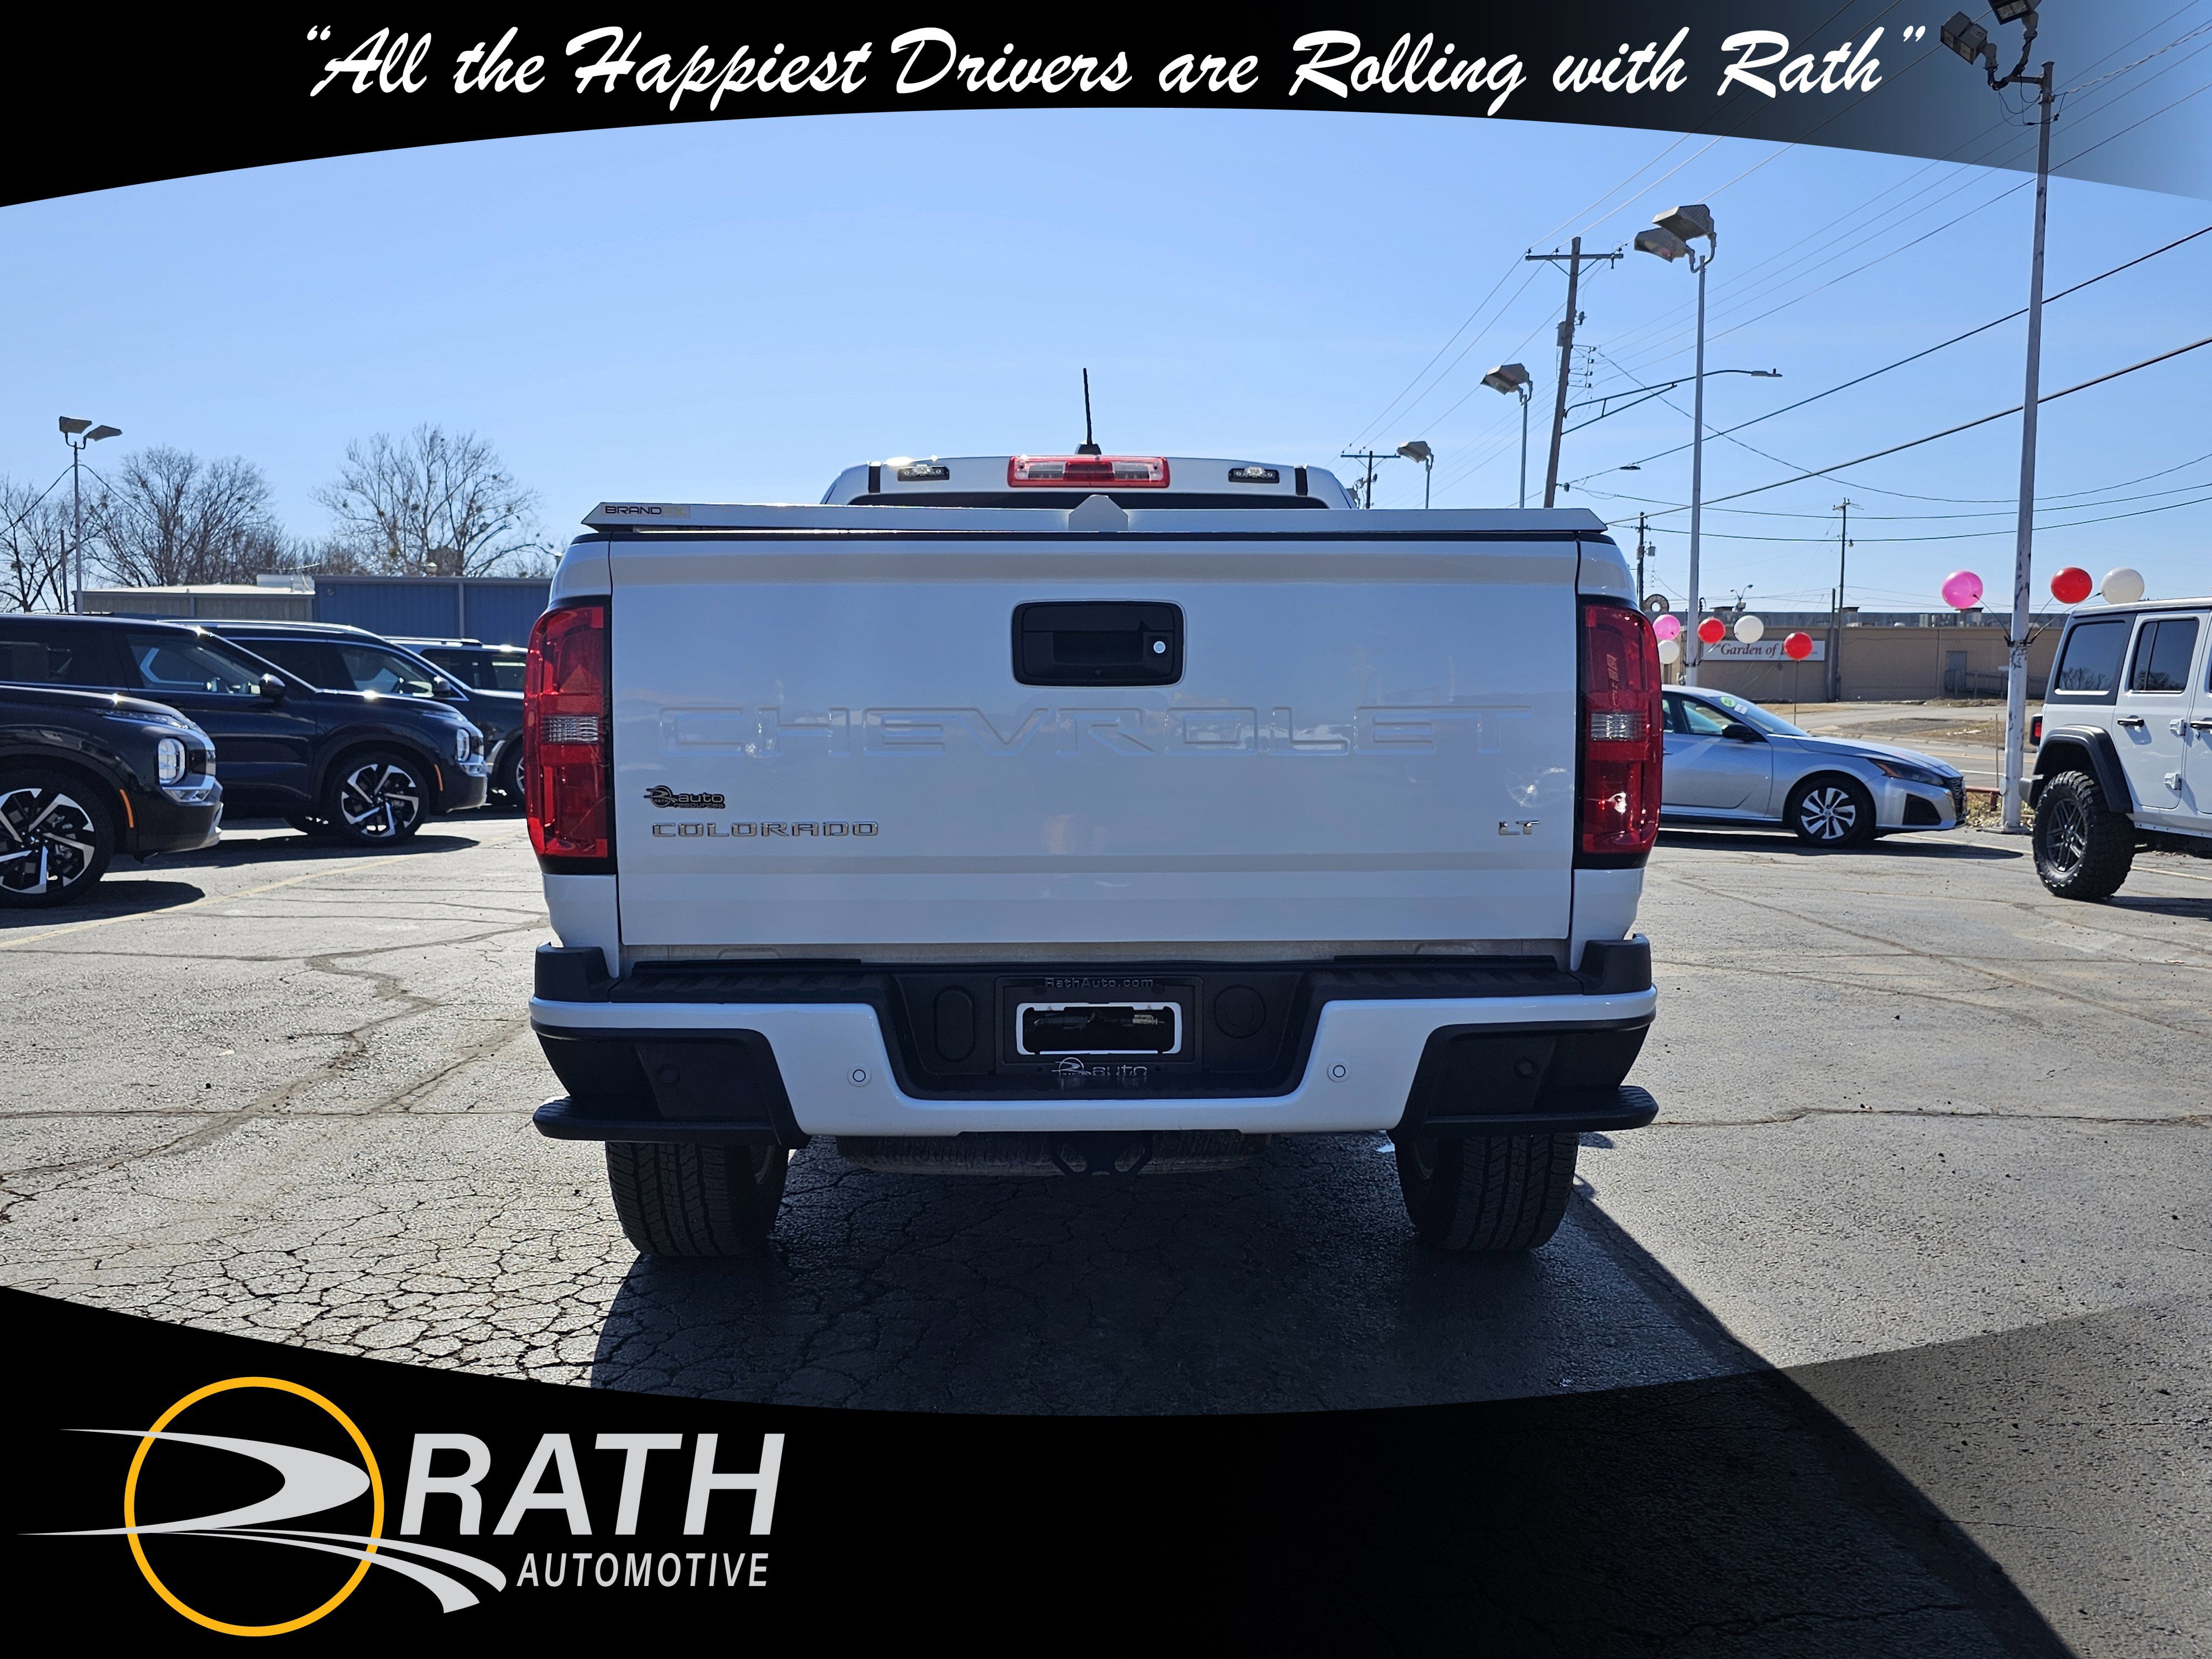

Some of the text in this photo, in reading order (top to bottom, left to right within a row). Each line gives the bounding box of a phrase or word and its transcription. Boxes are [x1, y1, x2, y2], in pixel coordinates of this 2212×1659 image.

[1720, 643, 1762, 655] Garden
[1765, 643, 1779, 658] of
[658, 705, 1532, 757] CHEVROLET
[679, 793, 723, 802] auto
[652, 821, 879, 837] COLORADO
[1499, 820, 1540, 835] LT
[1045, 977, 1154, 988] RathAuto.com
